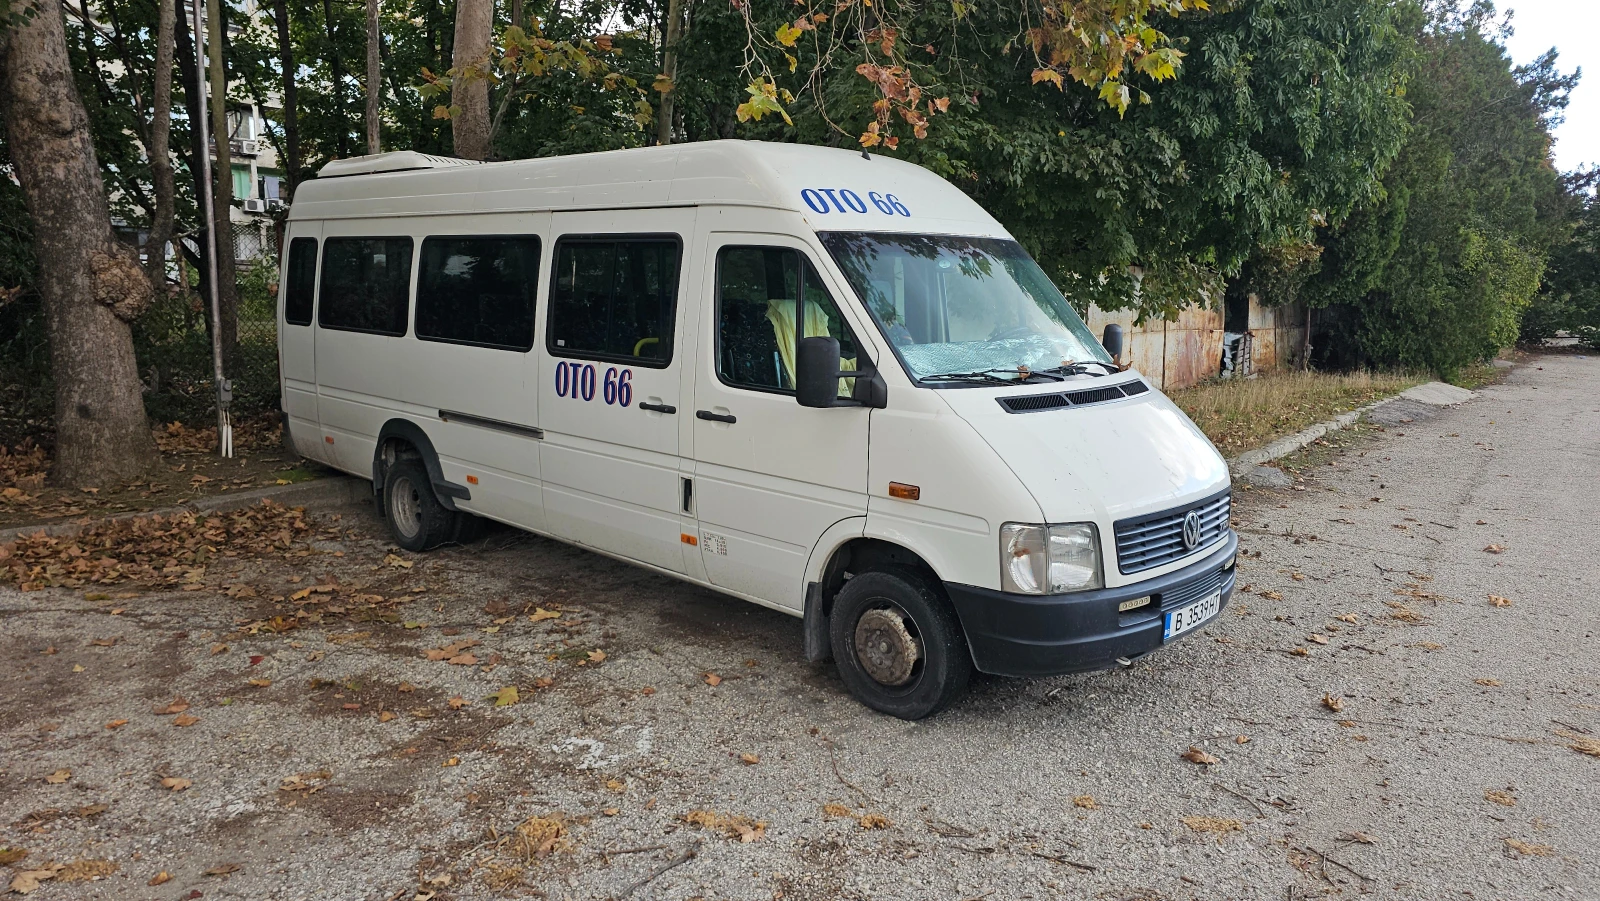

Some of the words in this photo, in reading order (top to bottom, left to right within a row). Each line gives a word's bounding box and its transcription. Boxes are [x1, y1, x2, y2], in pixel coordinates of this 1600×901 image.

[800, 188, 868, 214] OTO
[868, 191, 911, 218] 66
[555, 361, 597, 402] OTO
[603, 366, 633, 408] 66
[1184, 510, 1201, 550] VW
[1175, 612, 1183, 631] B
